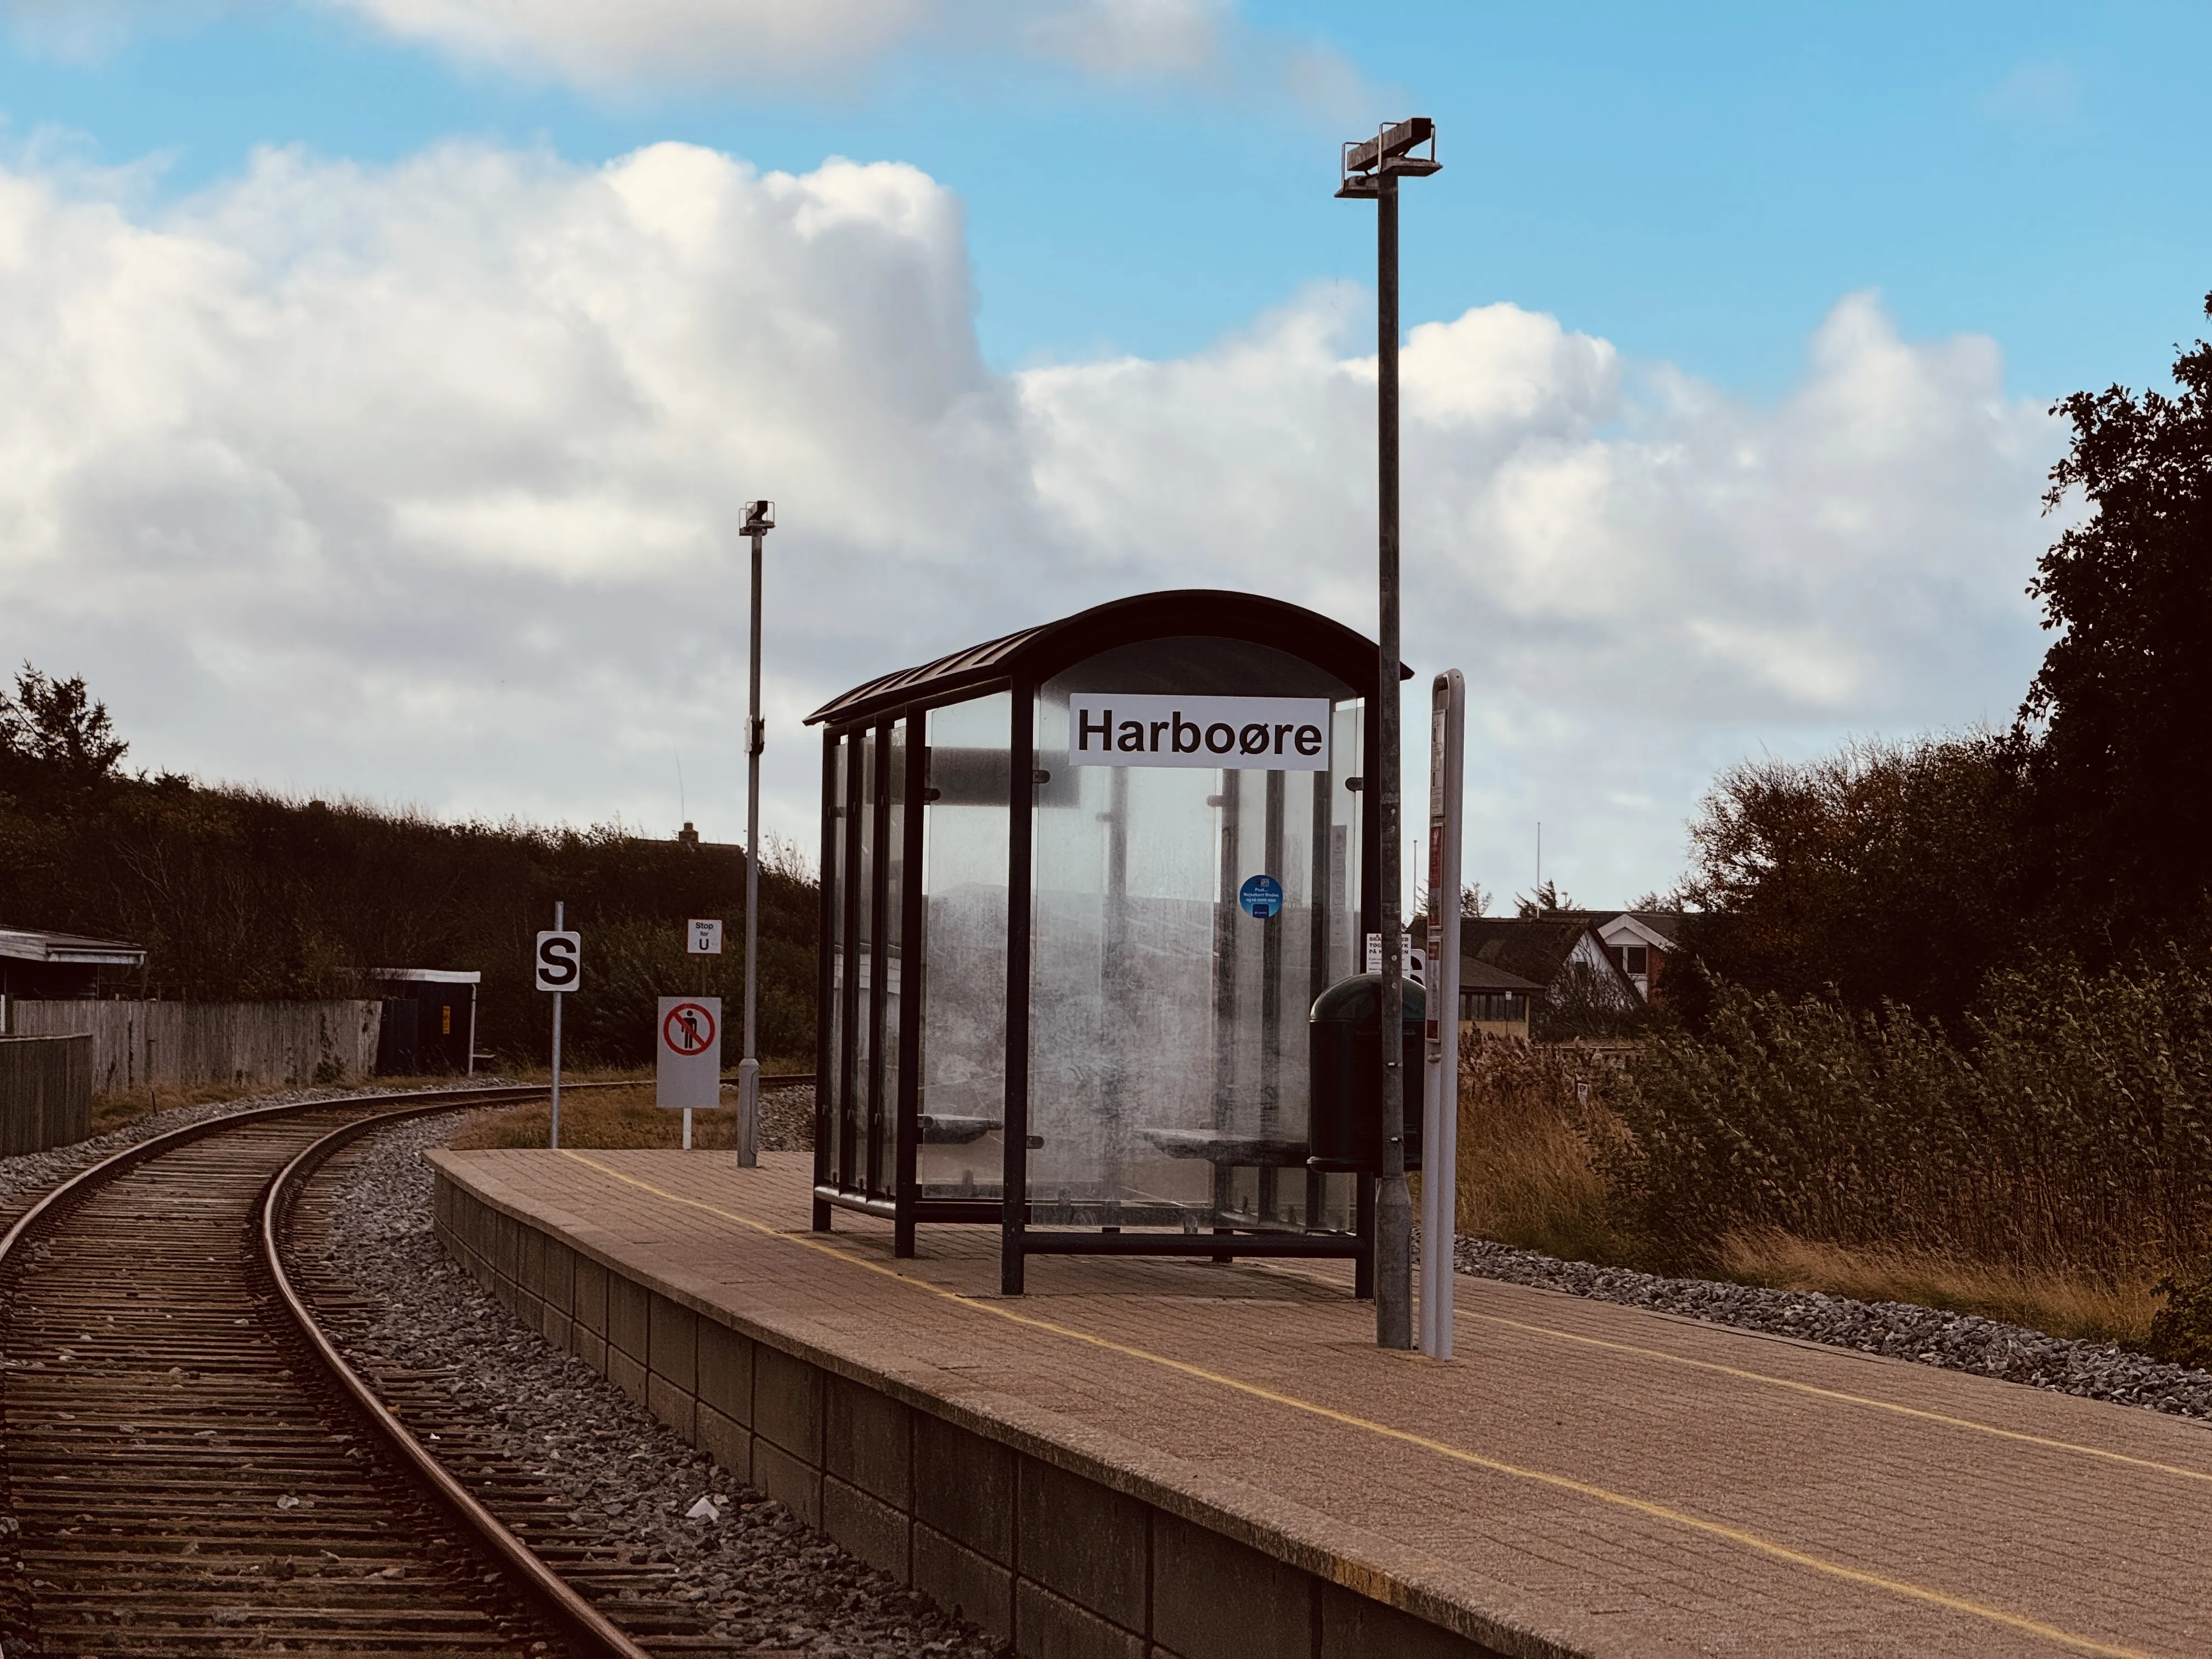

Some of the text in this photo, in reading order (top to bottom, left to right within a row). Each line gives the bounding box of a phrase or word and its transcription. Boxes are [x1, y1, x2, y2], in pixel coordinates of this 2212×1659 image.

[1079, 709, 1322, 755] Harboøre
[696, 922, 714, 930] Stop
[699, 938, 709, 950] U
[539, 938, 577, 985] S
